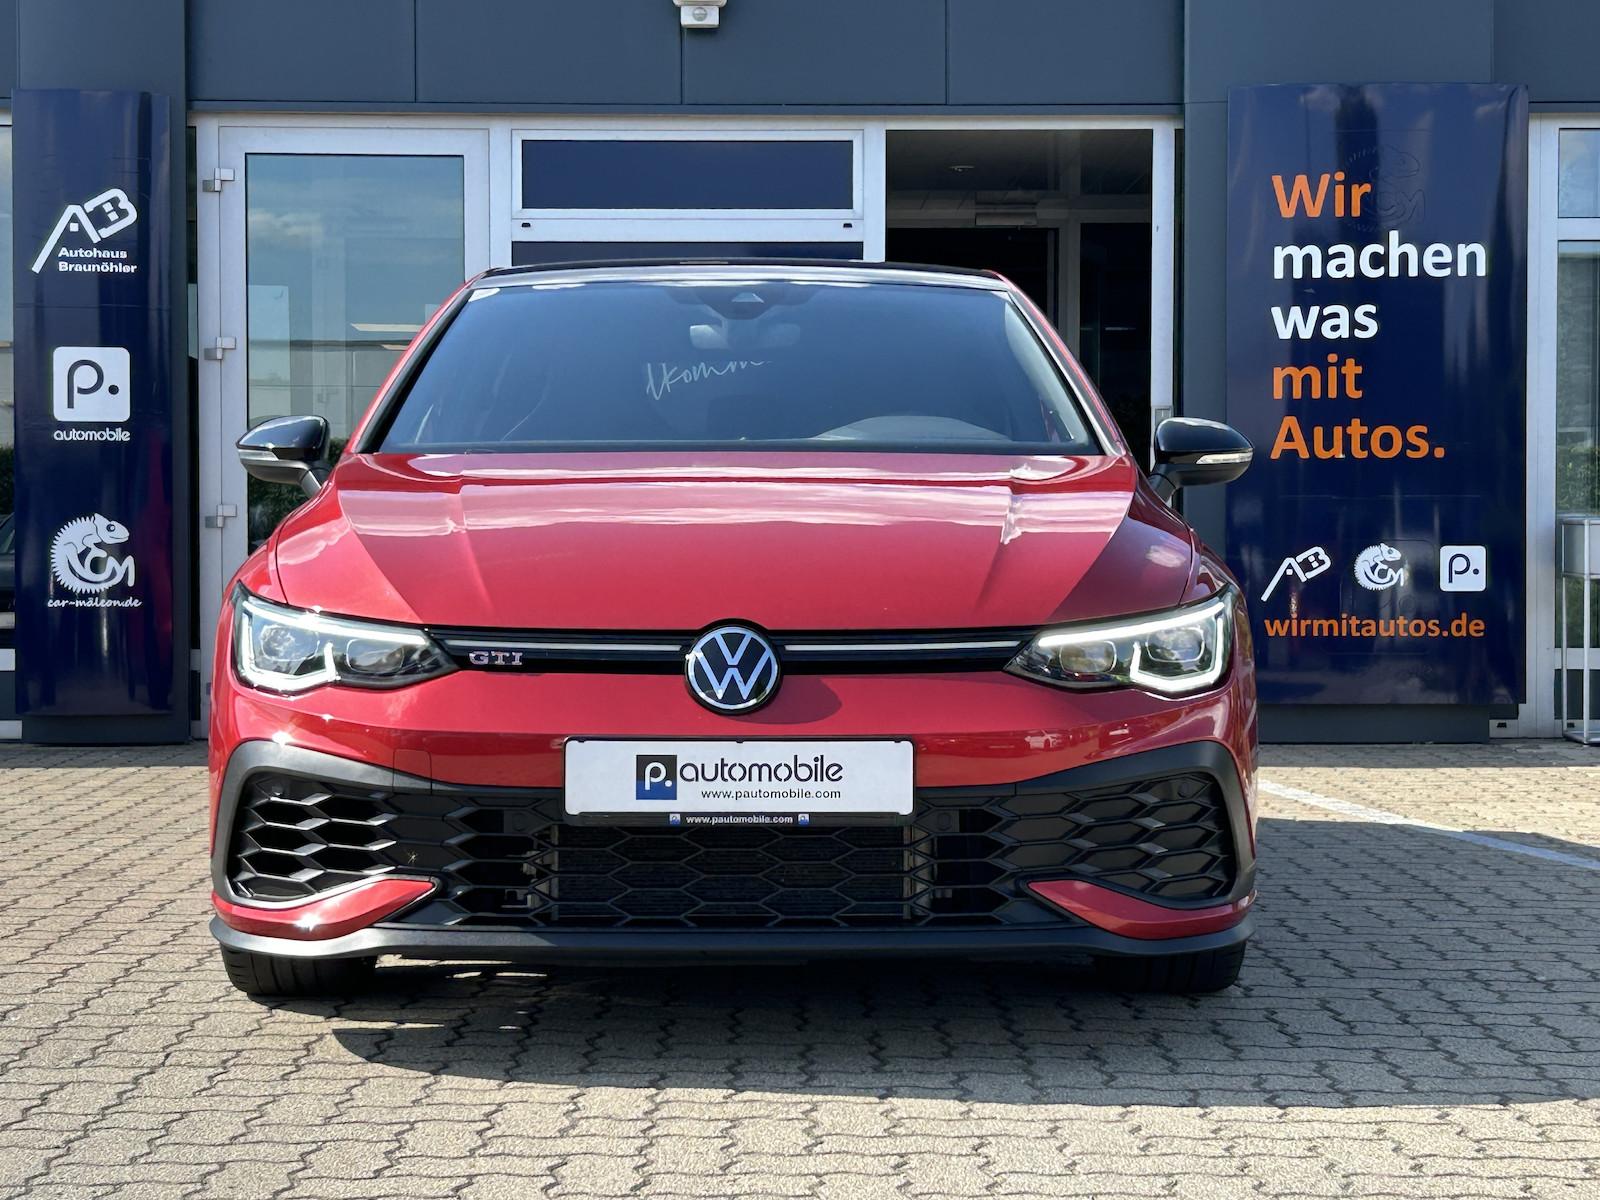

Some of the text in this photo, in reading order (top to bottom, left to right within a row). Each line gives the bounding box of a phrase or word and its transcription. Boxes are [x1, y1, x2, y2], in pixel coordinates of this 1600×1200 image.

[1271, 171, 1372, 218] Wir
[58, 247, 128, 259] Autohaus
[1273, 230, 1487, 279] machen
[58, 261, 138, 273] Braunöhler
[1270, 303, 1379, 340] was
[1272, 354, 1363, 400] mit
[53, 427, 131, 442] automobile
[1270, 416, 1446, 459] Autos.
[47, 596, 143, 608] car-mäleon.de
[1264, 612, 1486, 637] wirmitautos.de
[468, 650, 523, 666] GTI
[679, 754, 844, 783] automobile
[701, 788, 841, 801] www.pautomobile.com
[686, 815, 794, 826] www.pautomobile.com
